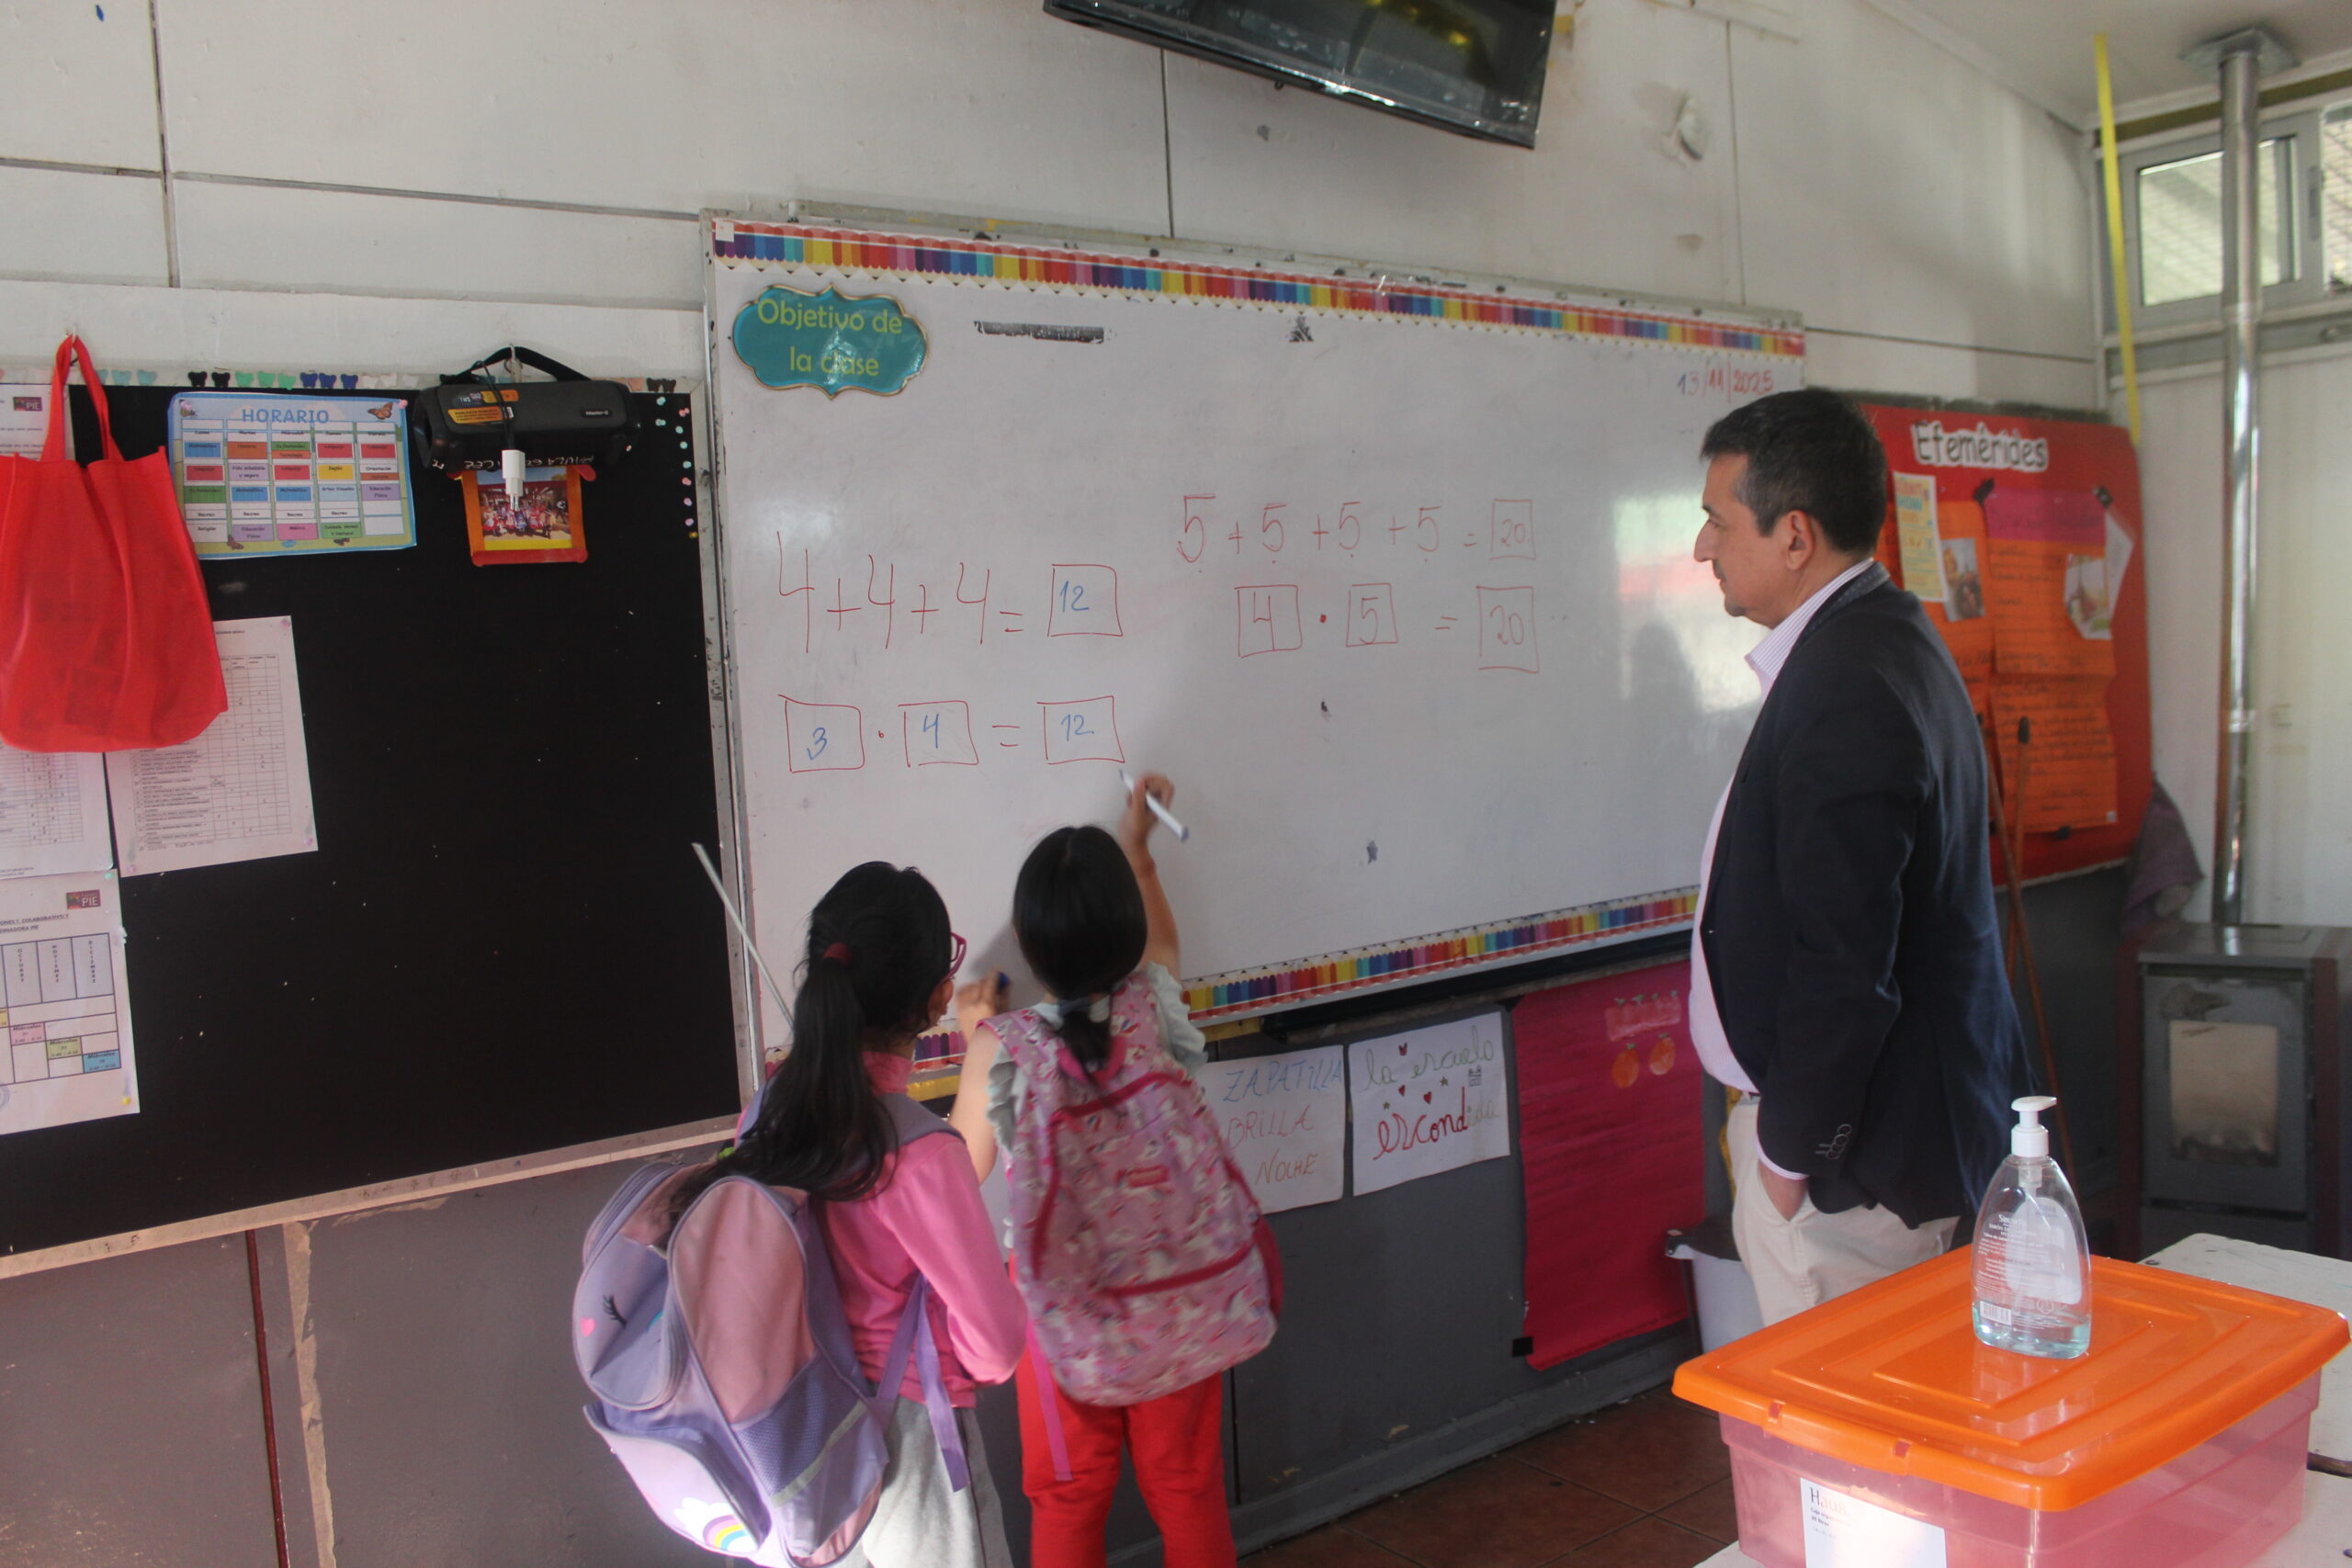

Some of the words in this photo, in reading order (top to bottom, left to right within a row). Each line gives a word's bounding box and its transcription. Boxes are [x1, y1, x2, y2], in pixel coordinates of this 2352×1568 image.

[757, 298, 865, 336] Objetivo
[873, 309, 903, 334] de
[789, 346, 812, 373] la
[820, 347, 879, 377] clase
[242, 408, 329, 423] HORARIO
[1914, 419, 2047, 468] Efemérides
[1176, 493, 1216, 563] 5
[1262, 502, 1287, 552] 5
[1339, 502, 1362, 550] 5
[1418, 506, 1442, 552] 5
[1500, 518, 1527, 547] 20
[777, 531, 816, 654] 4
[867, 553, 896, 649] 4
[956, 561, 990, 645] 4
[1059, 580, 1091, 614] 12
[1252, 591, 1276, 652] 4
[1360, 596, 1380, 645] 5
[1490, 604, 1525, 646] 20
[807, 727, 828, 761] 3
[922, 713, 940, 750] 4
[1060, 714, 1095, 741] 12
[1222, 1058, 1341, 1103] ZAPATILLA
[1227, 1103, 1315, 1150] BRILLA
[1254, 1147, 1319, 1186] NOCHE
